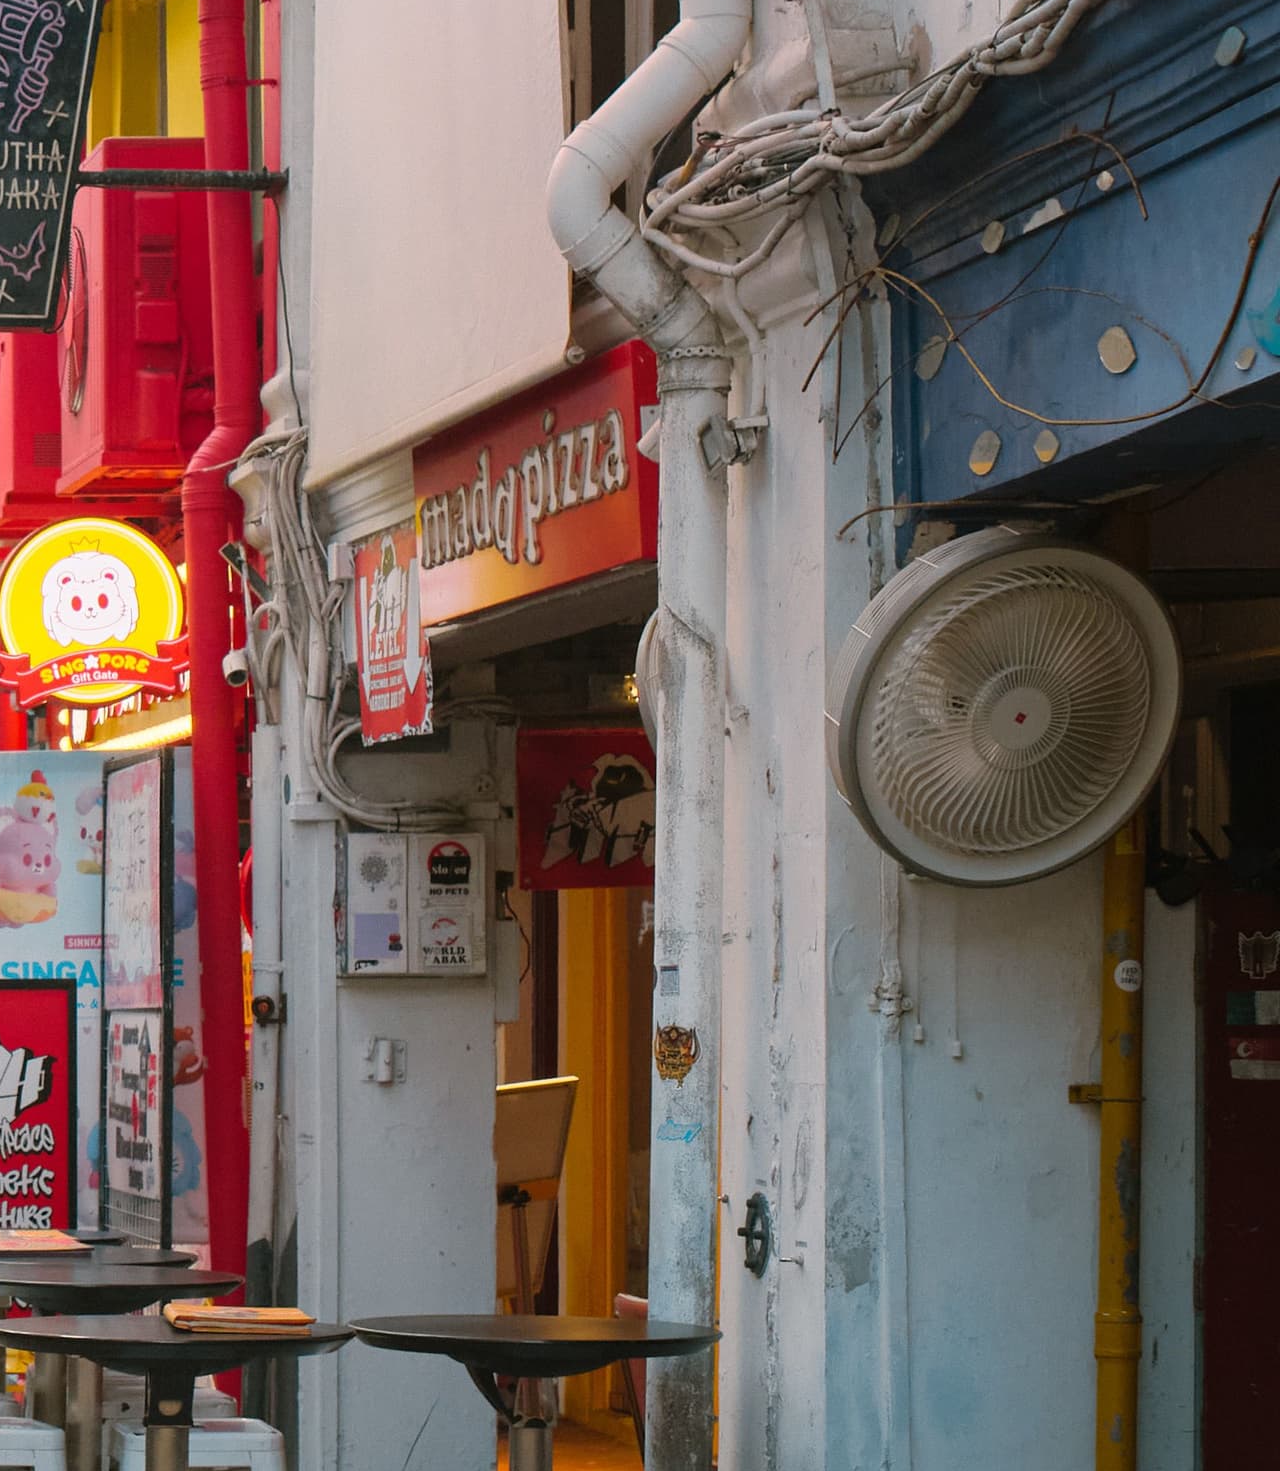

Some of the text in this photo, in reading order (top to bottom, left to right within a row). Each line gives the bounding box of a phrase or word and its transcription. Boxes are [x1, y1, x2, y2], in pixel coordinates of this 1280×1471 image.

[519, 408, 628, 565] pizza
[70, 670, 119, 684] Gift Gate
